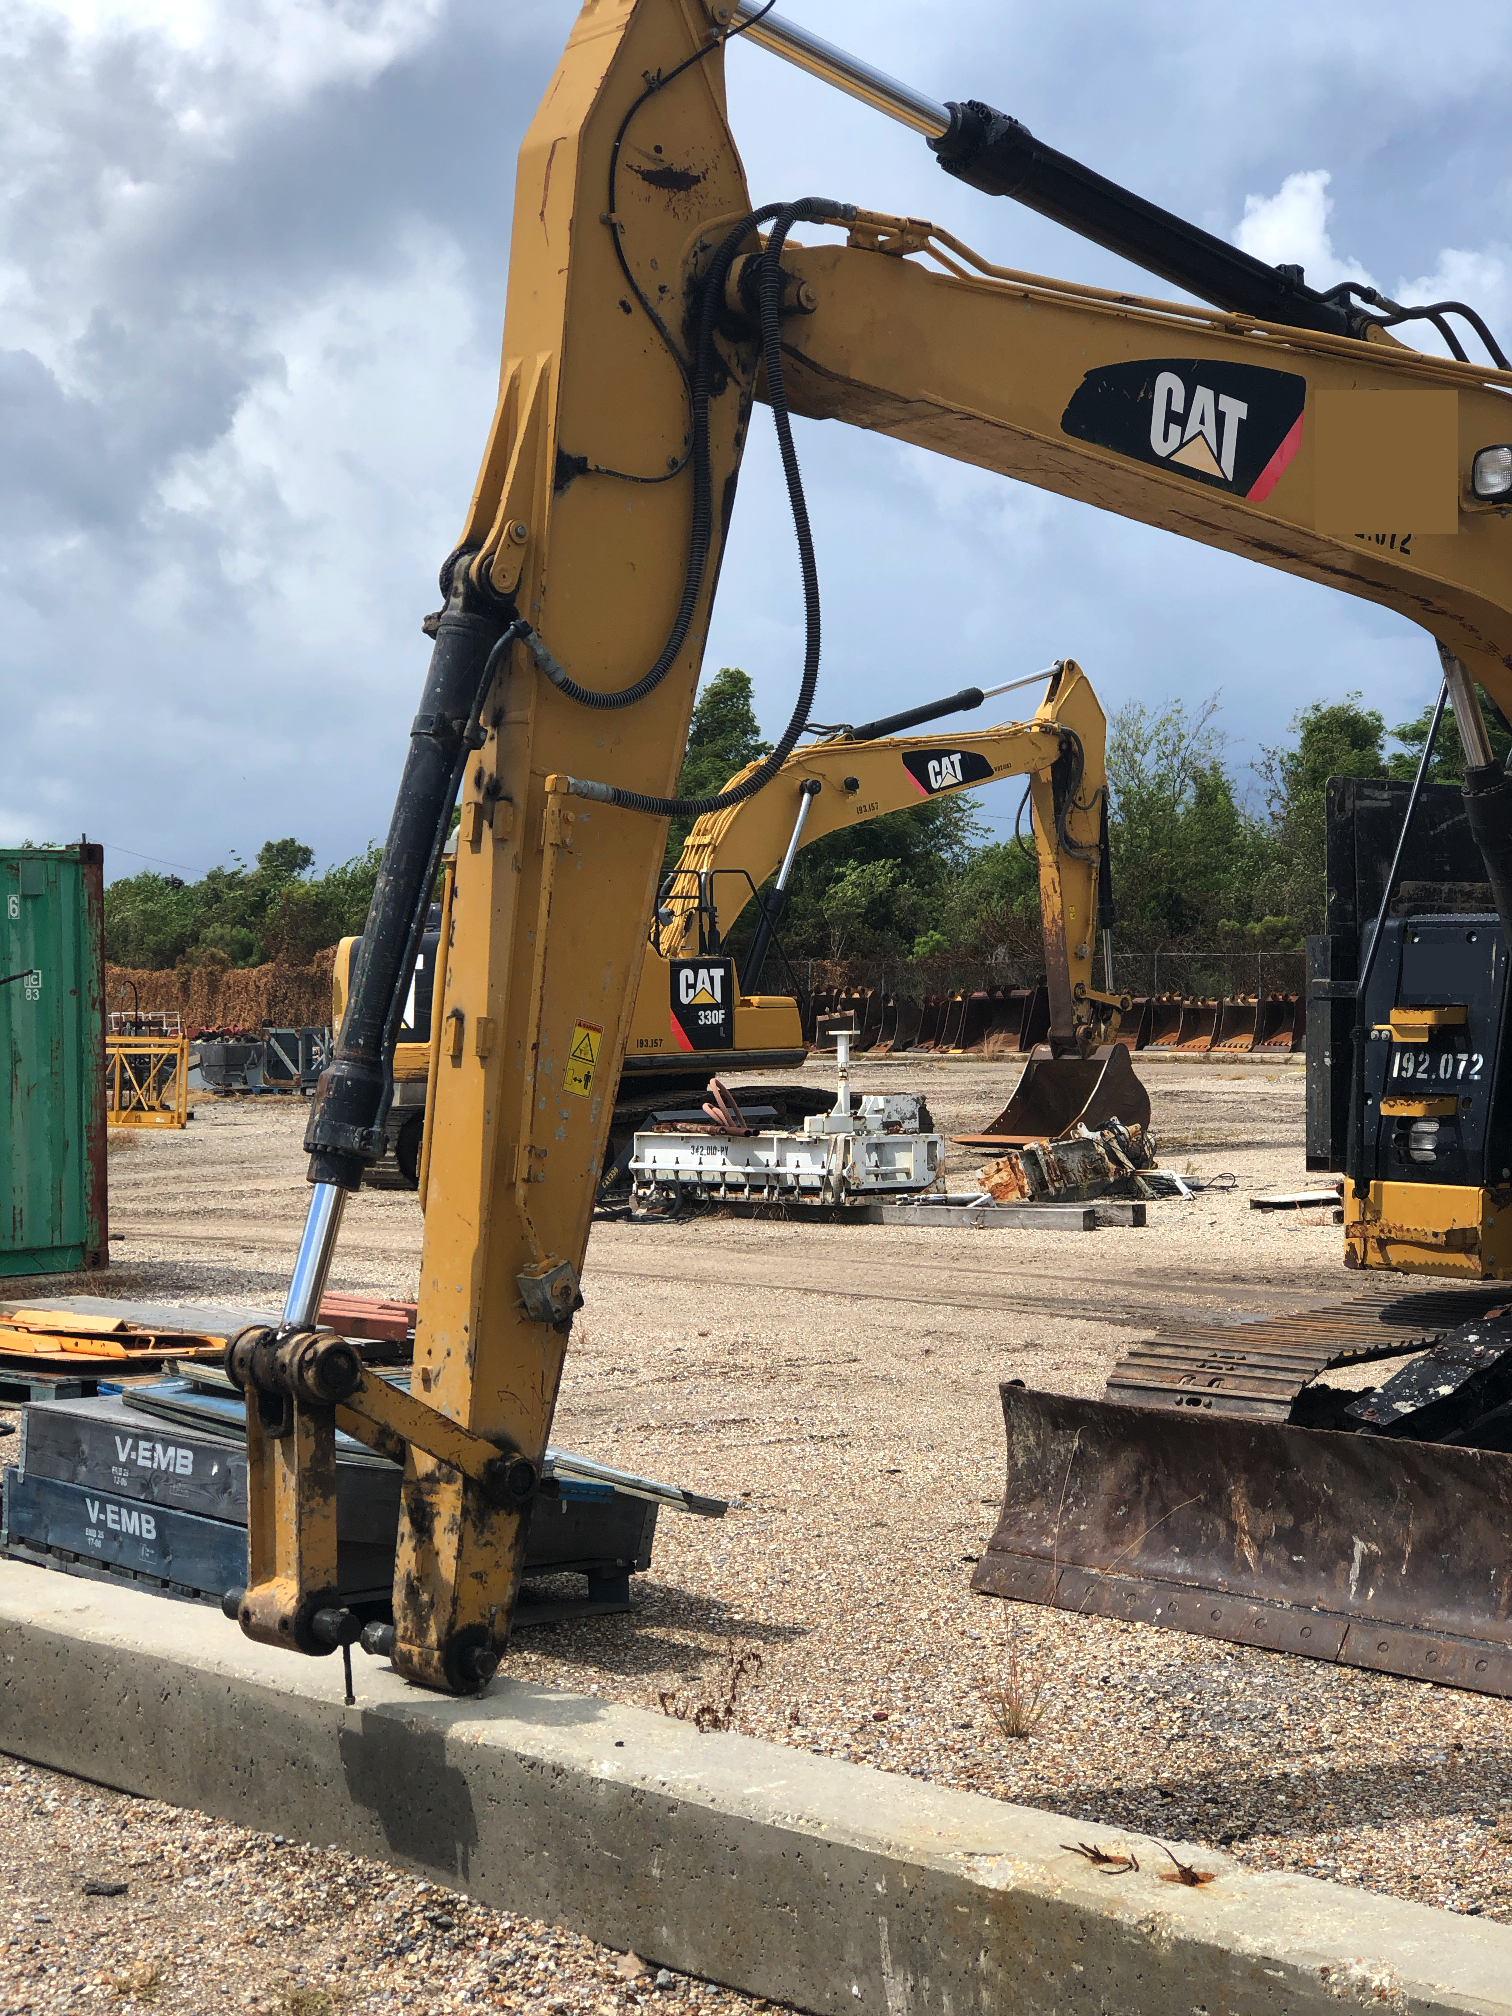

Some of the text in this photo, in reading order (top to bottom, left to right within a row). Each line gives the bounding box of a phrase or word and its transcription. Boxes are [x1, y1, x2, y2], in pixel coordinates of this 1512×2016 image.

[1150, 371, 1248, 481] CAT
[928, 753, 962, 789] CAT
[25, 989, 39, 1000] 83
[679, 968, 724, 1004] CAT
[698, 1010, 725, 1024] 330F
[636, 1038, 663, 1048] 193.157
[1392, 1052, 1484, 1079] 192.072
[115, 1436, 194, 1475] V-EMB
[85, 1498, 157, 1539] V-EMB
